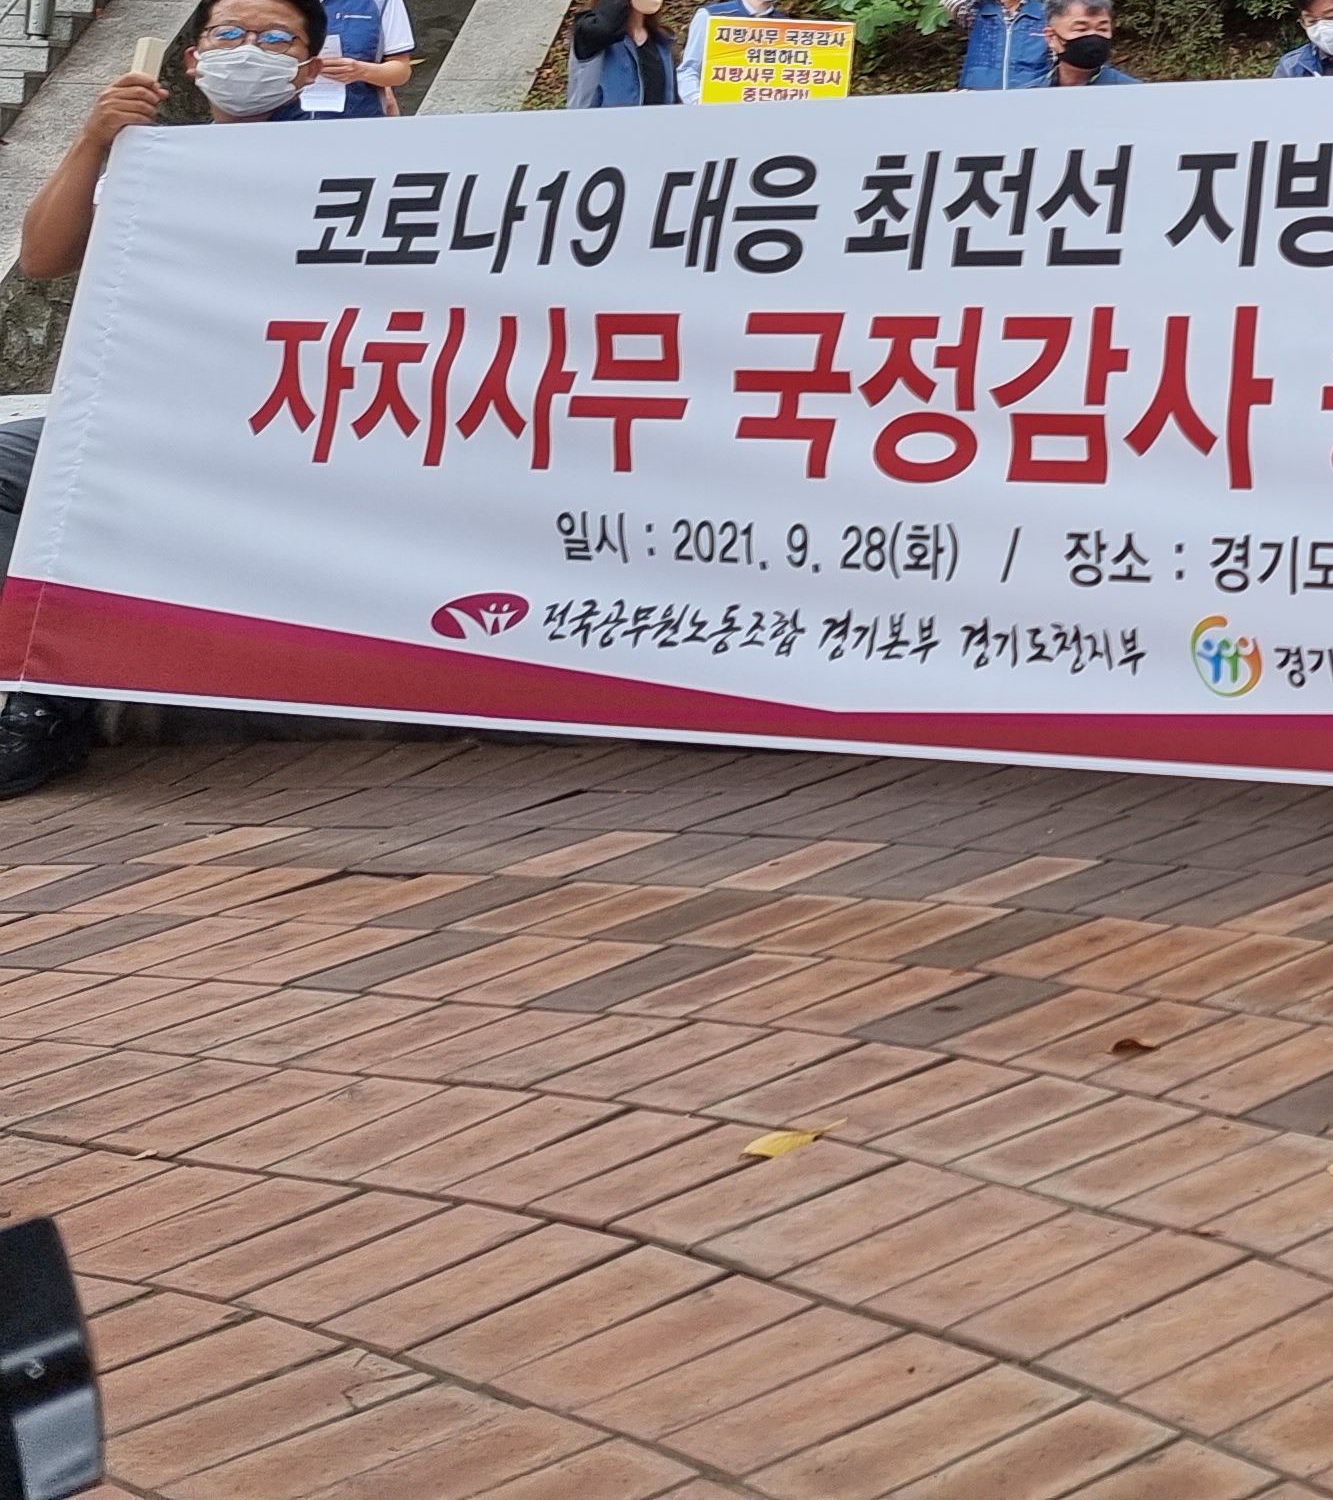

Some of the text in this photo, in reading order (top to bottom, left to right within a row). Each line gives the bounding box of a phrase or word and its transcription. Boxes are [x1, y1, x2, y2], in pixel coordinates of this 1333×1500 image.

[715, 27, 846, 47] 지방사무 국정감사
[747, 49, 812, 65] 위법하다.
[711, 67, 842, 85] 지방사무 국정감사
[295, 163, 627, 273] 코로나19
[649, 154, 819, 274] 대응
[845, 144, 1134, 270] 최전선
[249, 307, 690, 472] 자치사무
[733, 306, 1273, 490] 국정감사
[556, 511, 629, 563] 일시
[671, 519, 768, 571] 2021.
[786, 523, 822, 573] 9.
[840, 521, 960, 582] 28(화)
[1063, 529, 1153, 587] 장소
[541, 598, 1149, 675] 전국공무원노동조합 경기본부 경기도청지부
